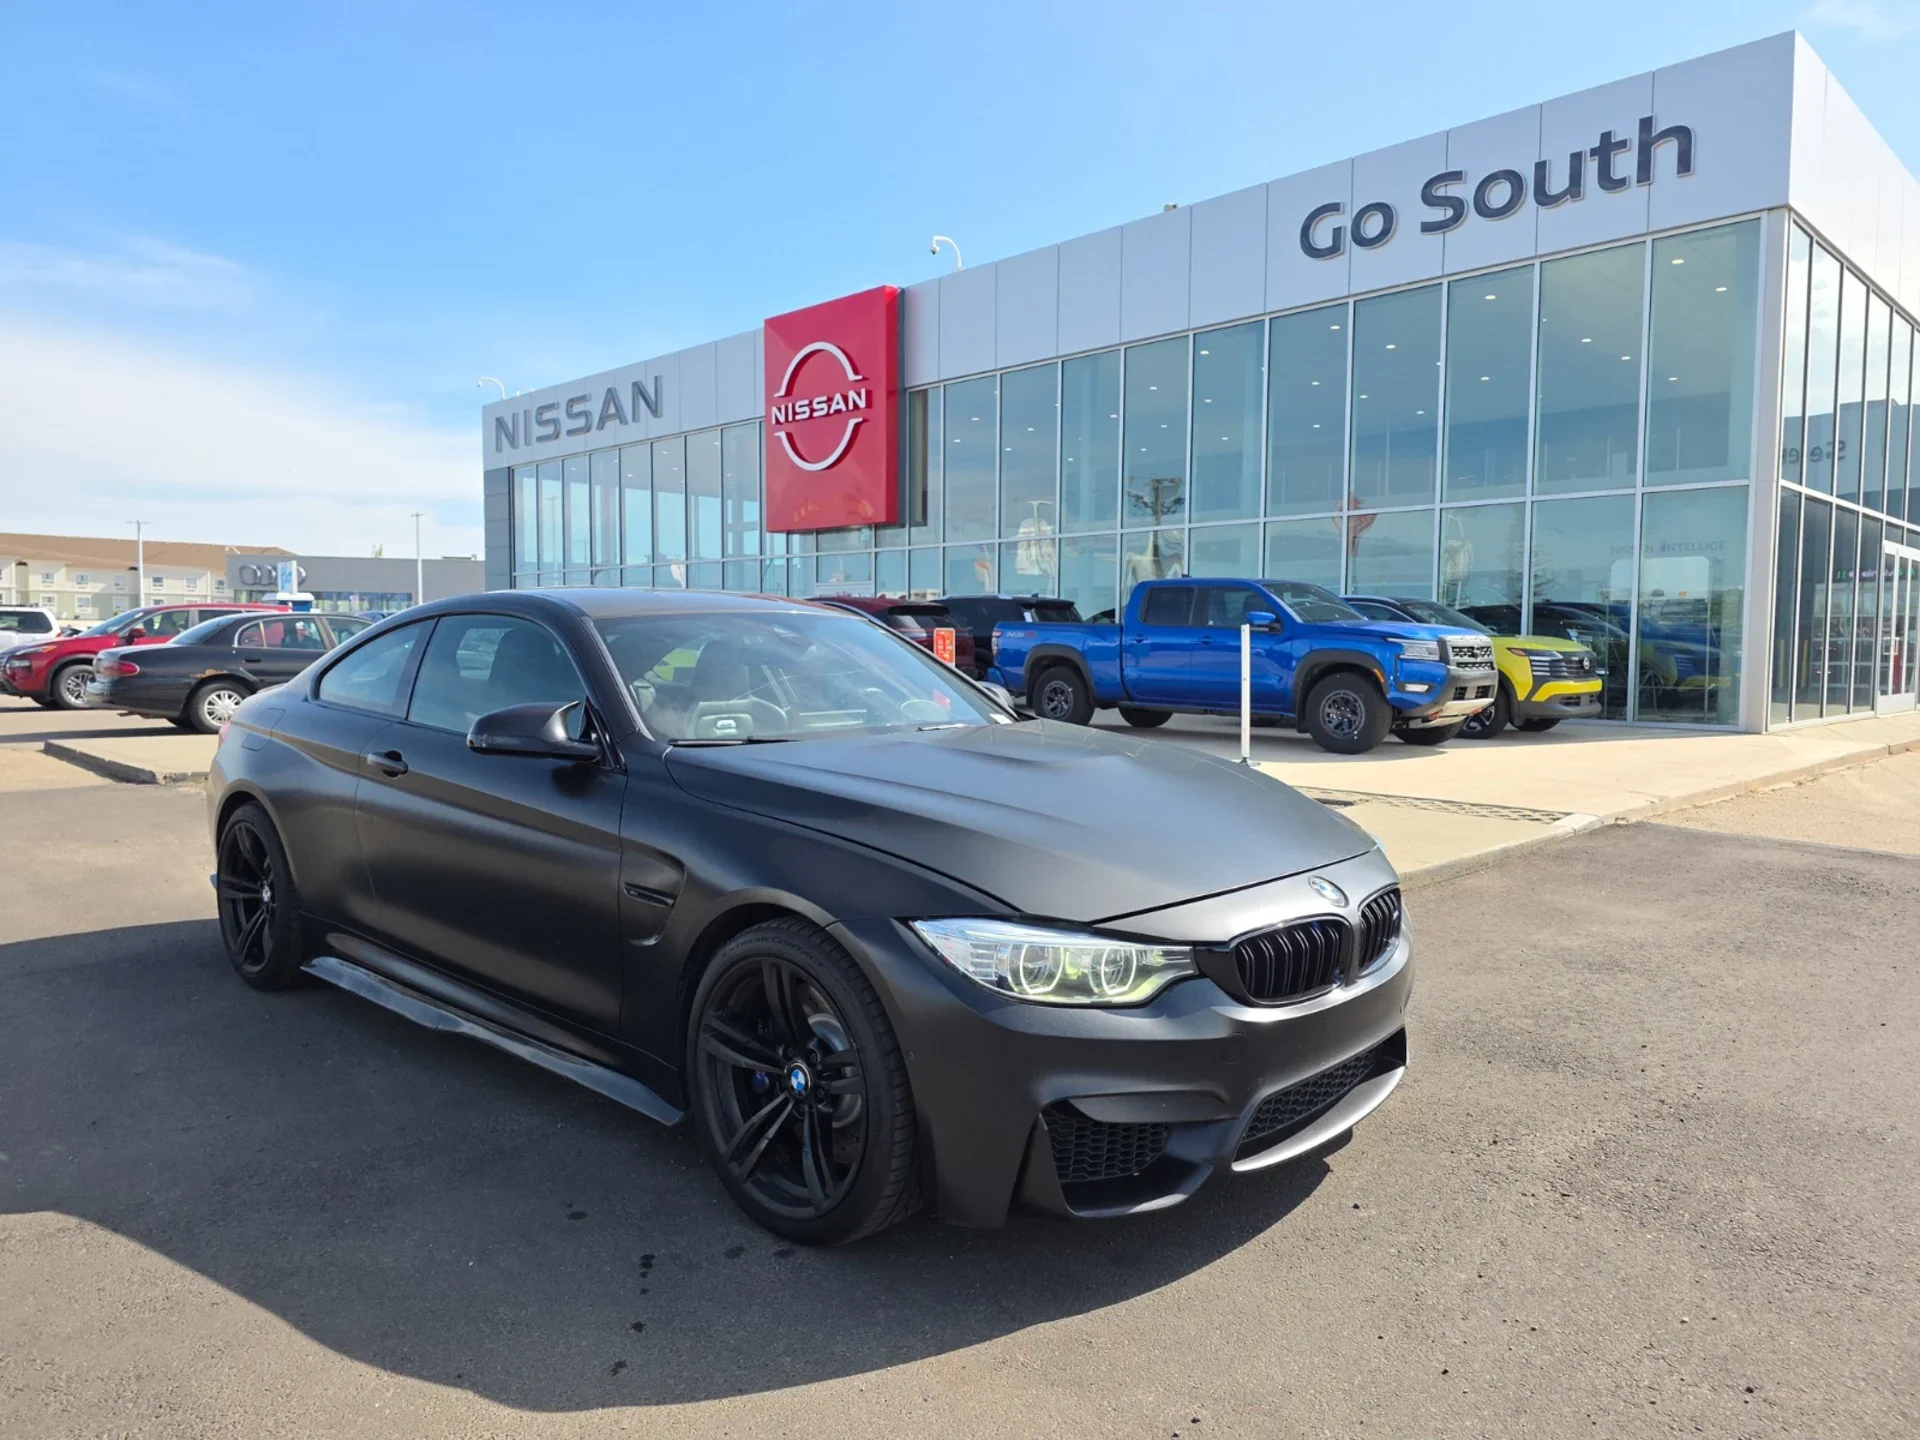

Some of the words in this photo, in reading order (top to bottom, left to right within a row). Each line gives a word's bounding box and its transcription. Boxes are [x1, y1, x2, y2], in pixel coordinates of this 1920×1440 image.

[1300, 202, 1397, 260] Go
[1420, 114, 1696, 235] South
[495, 375, 663, 453] NISSAN
[771, 388, 866, 425] NISSAN
